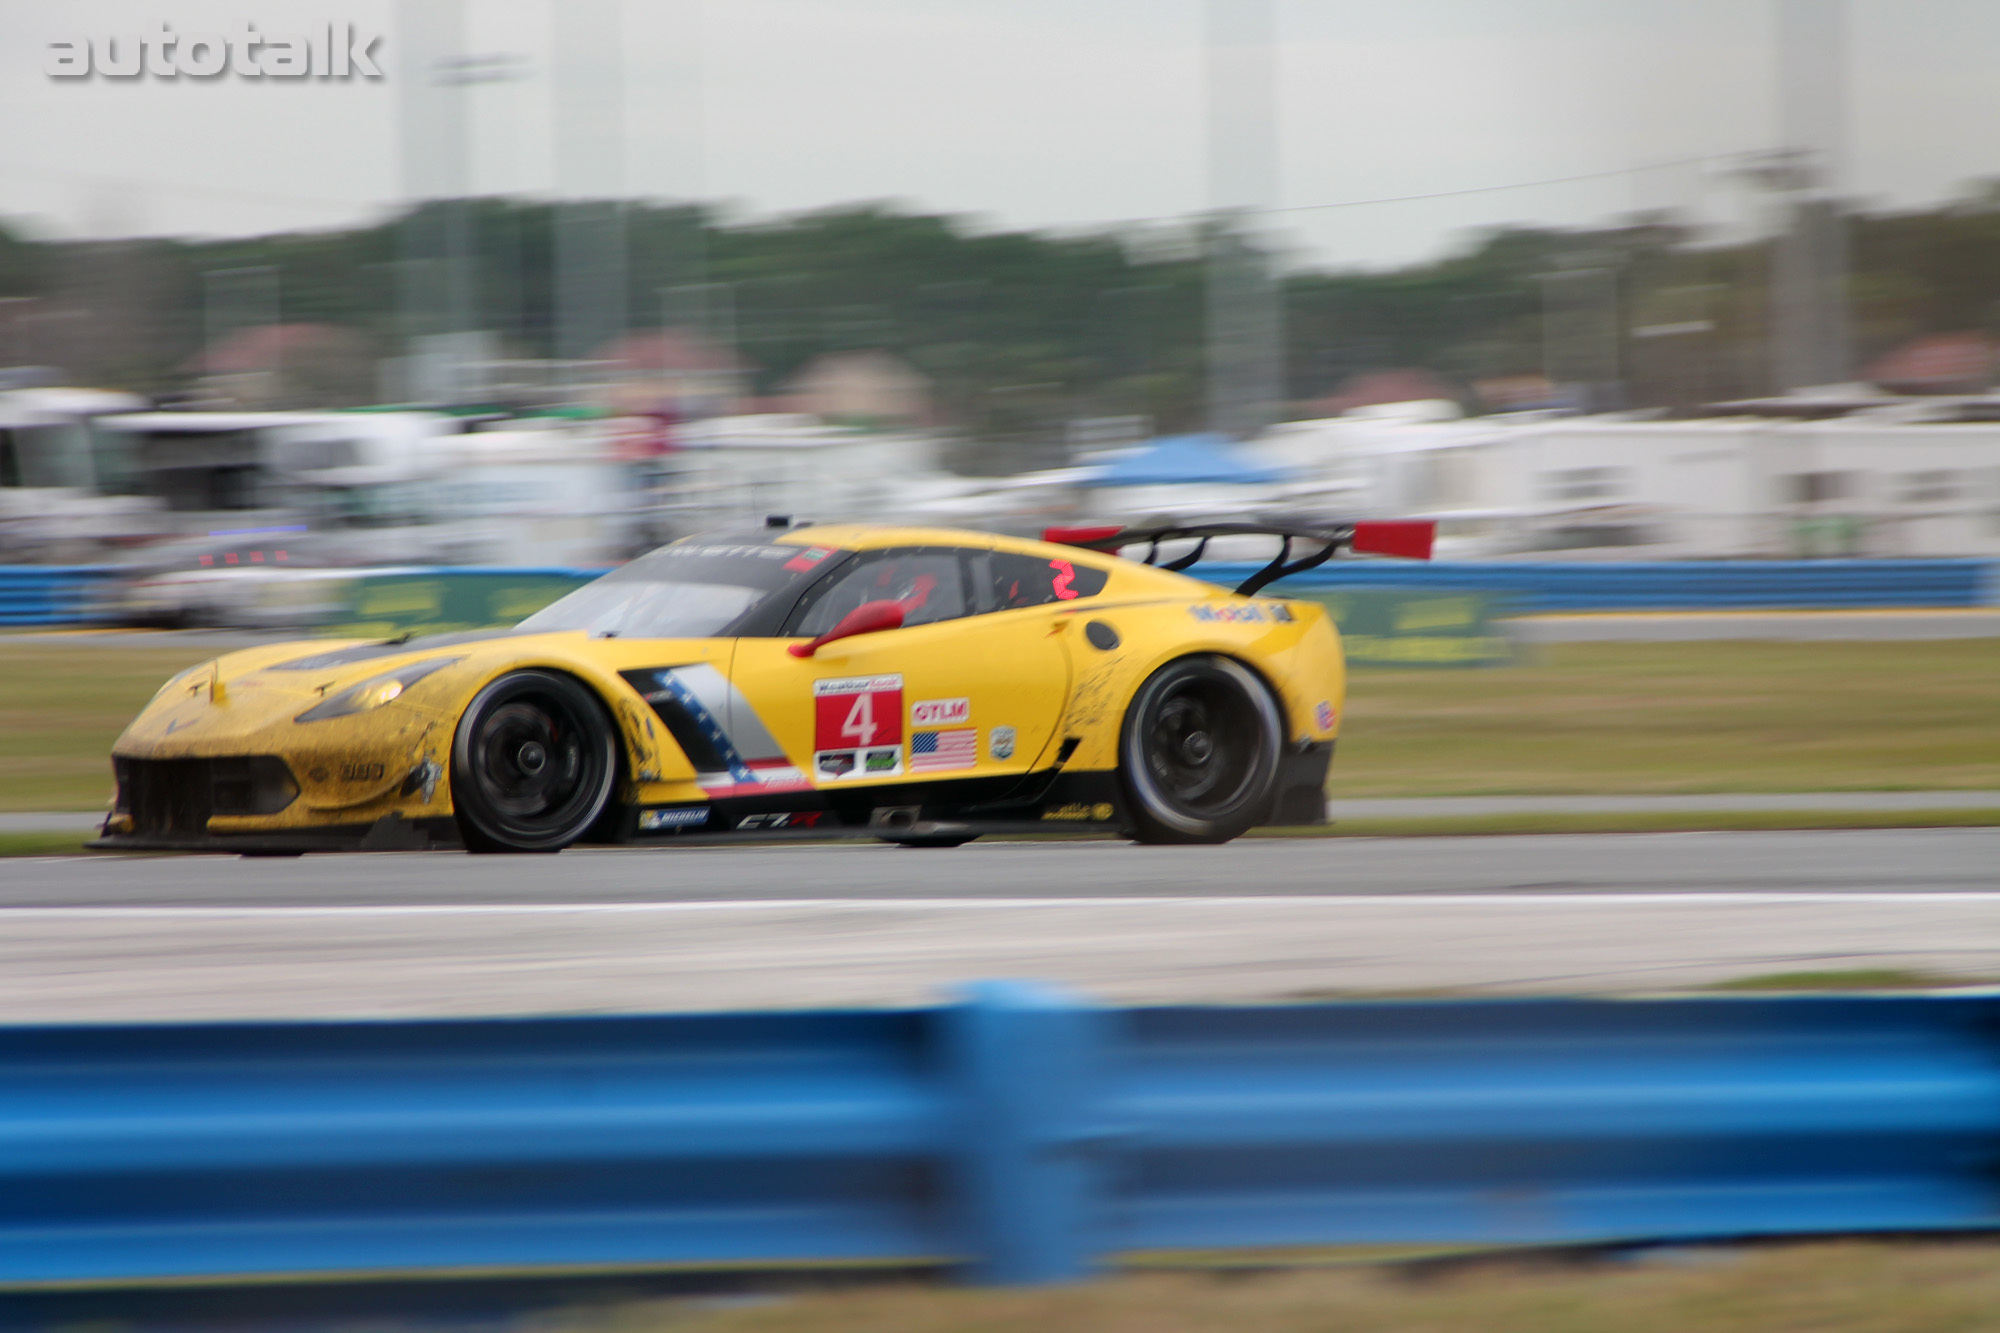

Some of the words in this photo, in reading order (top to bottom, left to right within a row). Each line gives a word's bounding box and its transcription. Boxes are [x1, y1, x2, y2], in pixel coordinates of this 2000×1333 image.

[841, 692, 878, 746] 4
[914, 701, 967, 721] GTLM
[661, 809, 709, 823] MICHELIN
